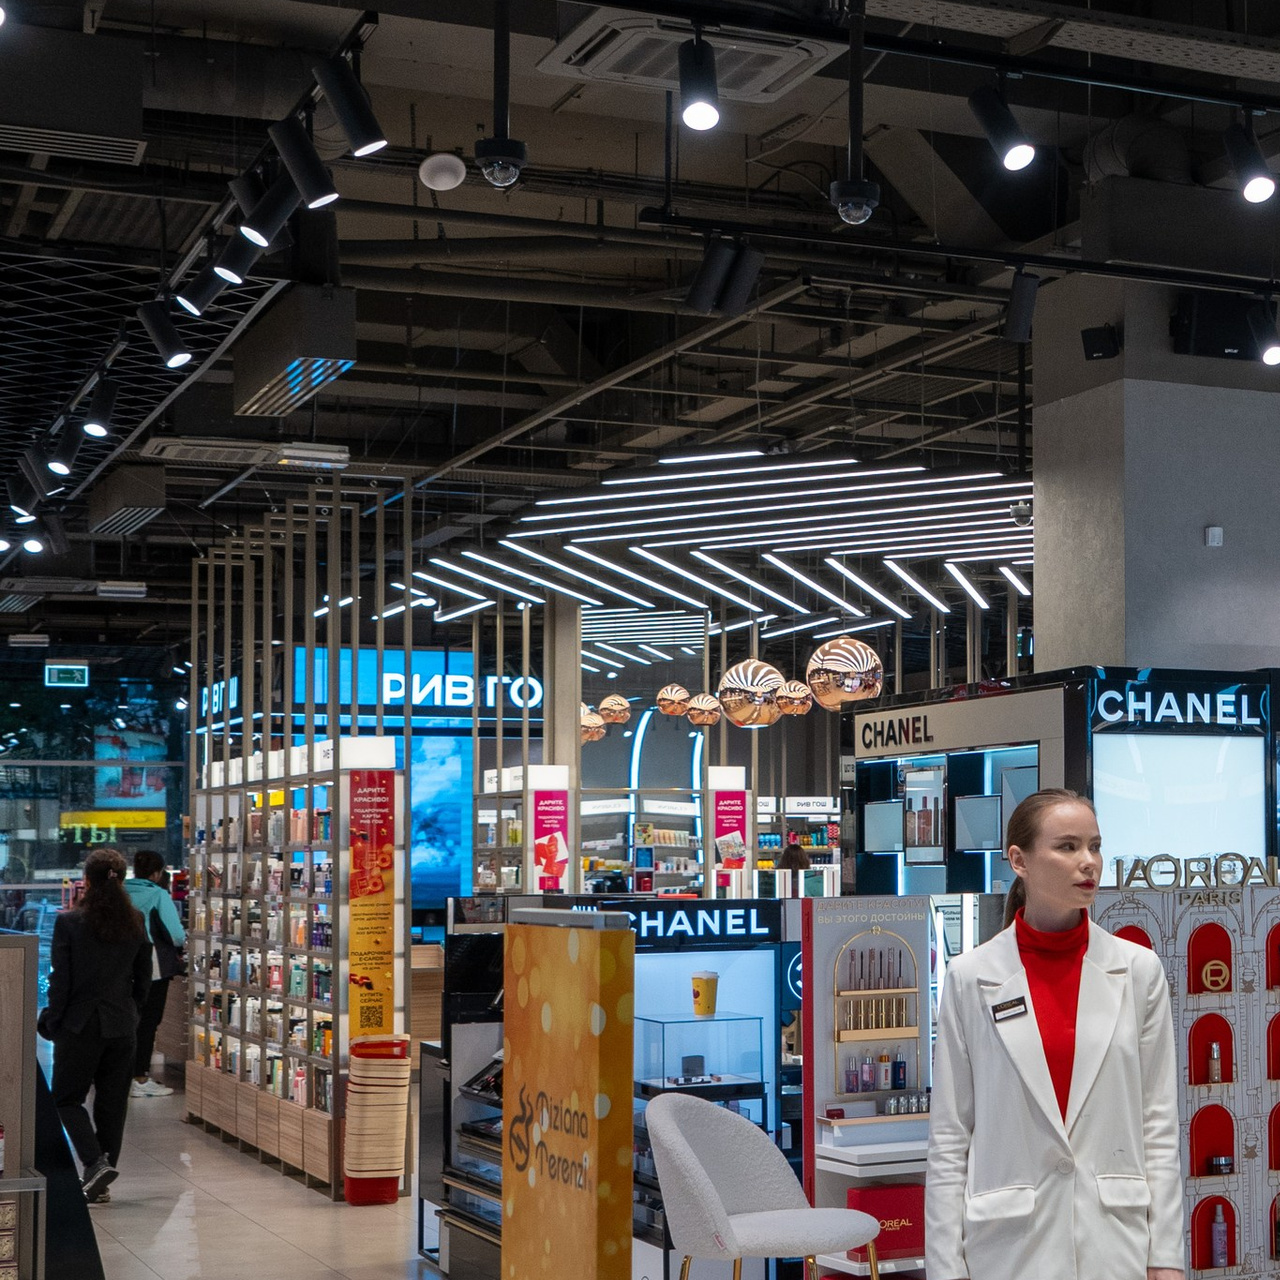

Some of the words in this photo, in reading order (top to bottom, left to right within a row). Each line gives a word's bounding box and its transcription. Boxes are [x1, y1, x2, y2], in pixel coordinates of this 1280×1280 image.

[383, 673, 475, 706] РИВ
[485, 676, 544, 708] ГО
[1097, 690, 1261, 725] CHANEL
[862, 715, 934, 749] CHANEL
[817, 899, 863, 911] ДАРИТЕ
[1179, 891, 1241, 906] PARIS
[817, 915, 833, 923] ВЫ
[836, 914, 867, 923] ЭТОГО
[869, 912, 926, 923] ДОСТОЙНЫ
[536, 1091, 588, 1139] Tiziana
[535, 1140, 588, 1190] Terenzi
[878, 1218, 913, 1229] ORÉAL
